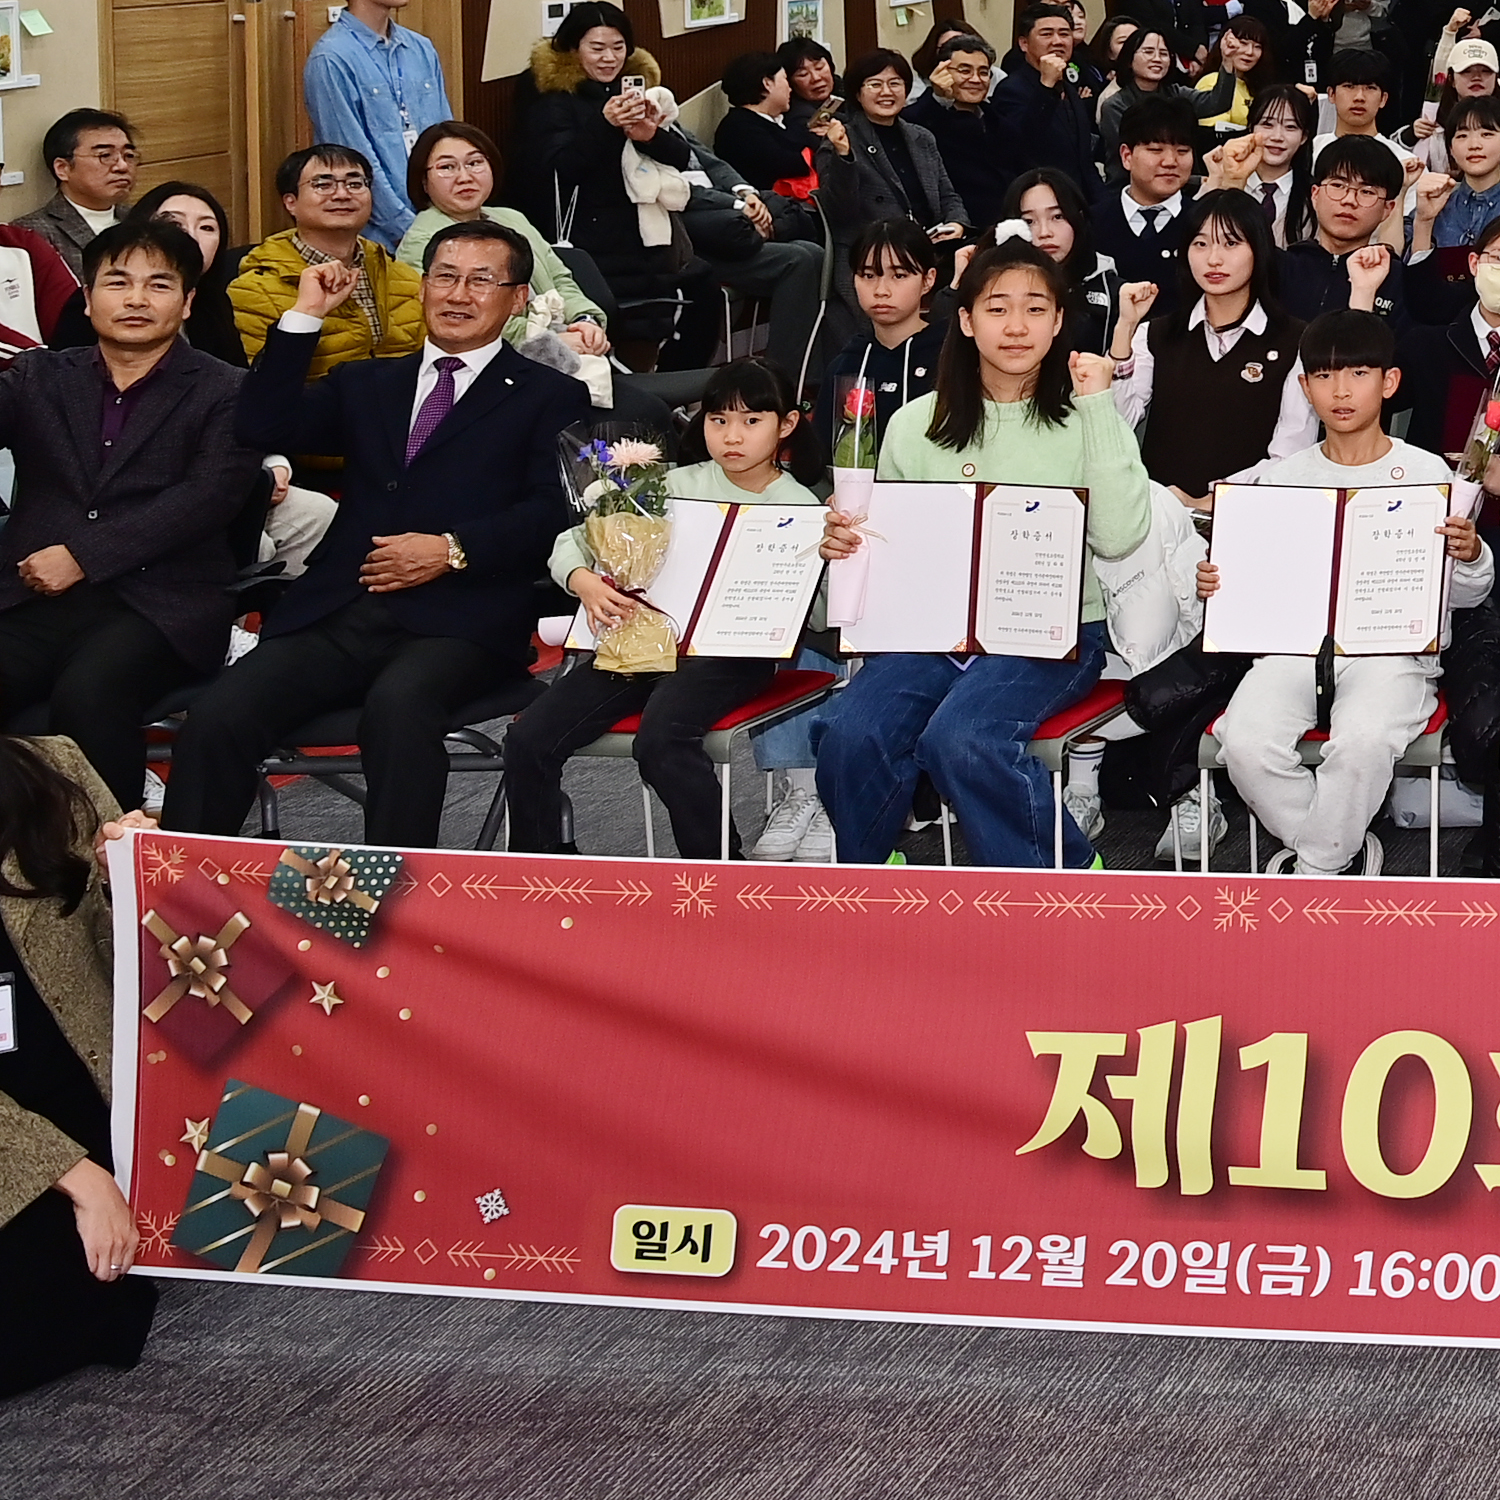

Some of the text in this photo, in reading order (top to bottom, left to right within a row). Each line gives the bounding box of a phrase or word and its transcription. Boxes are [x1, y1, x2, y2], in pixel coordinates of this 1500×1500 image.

[1010, 529, 1053, 541] 장학증서
[1372, 528, 1415, 540] 장학증서
[632, 1220, 713, 1264] 일시
[756, 1223, 949, 1282] 2024년
[968, 1234, 1087, 1289] 12월
[1105, 1239, 1331, 1298] 20일(금)
